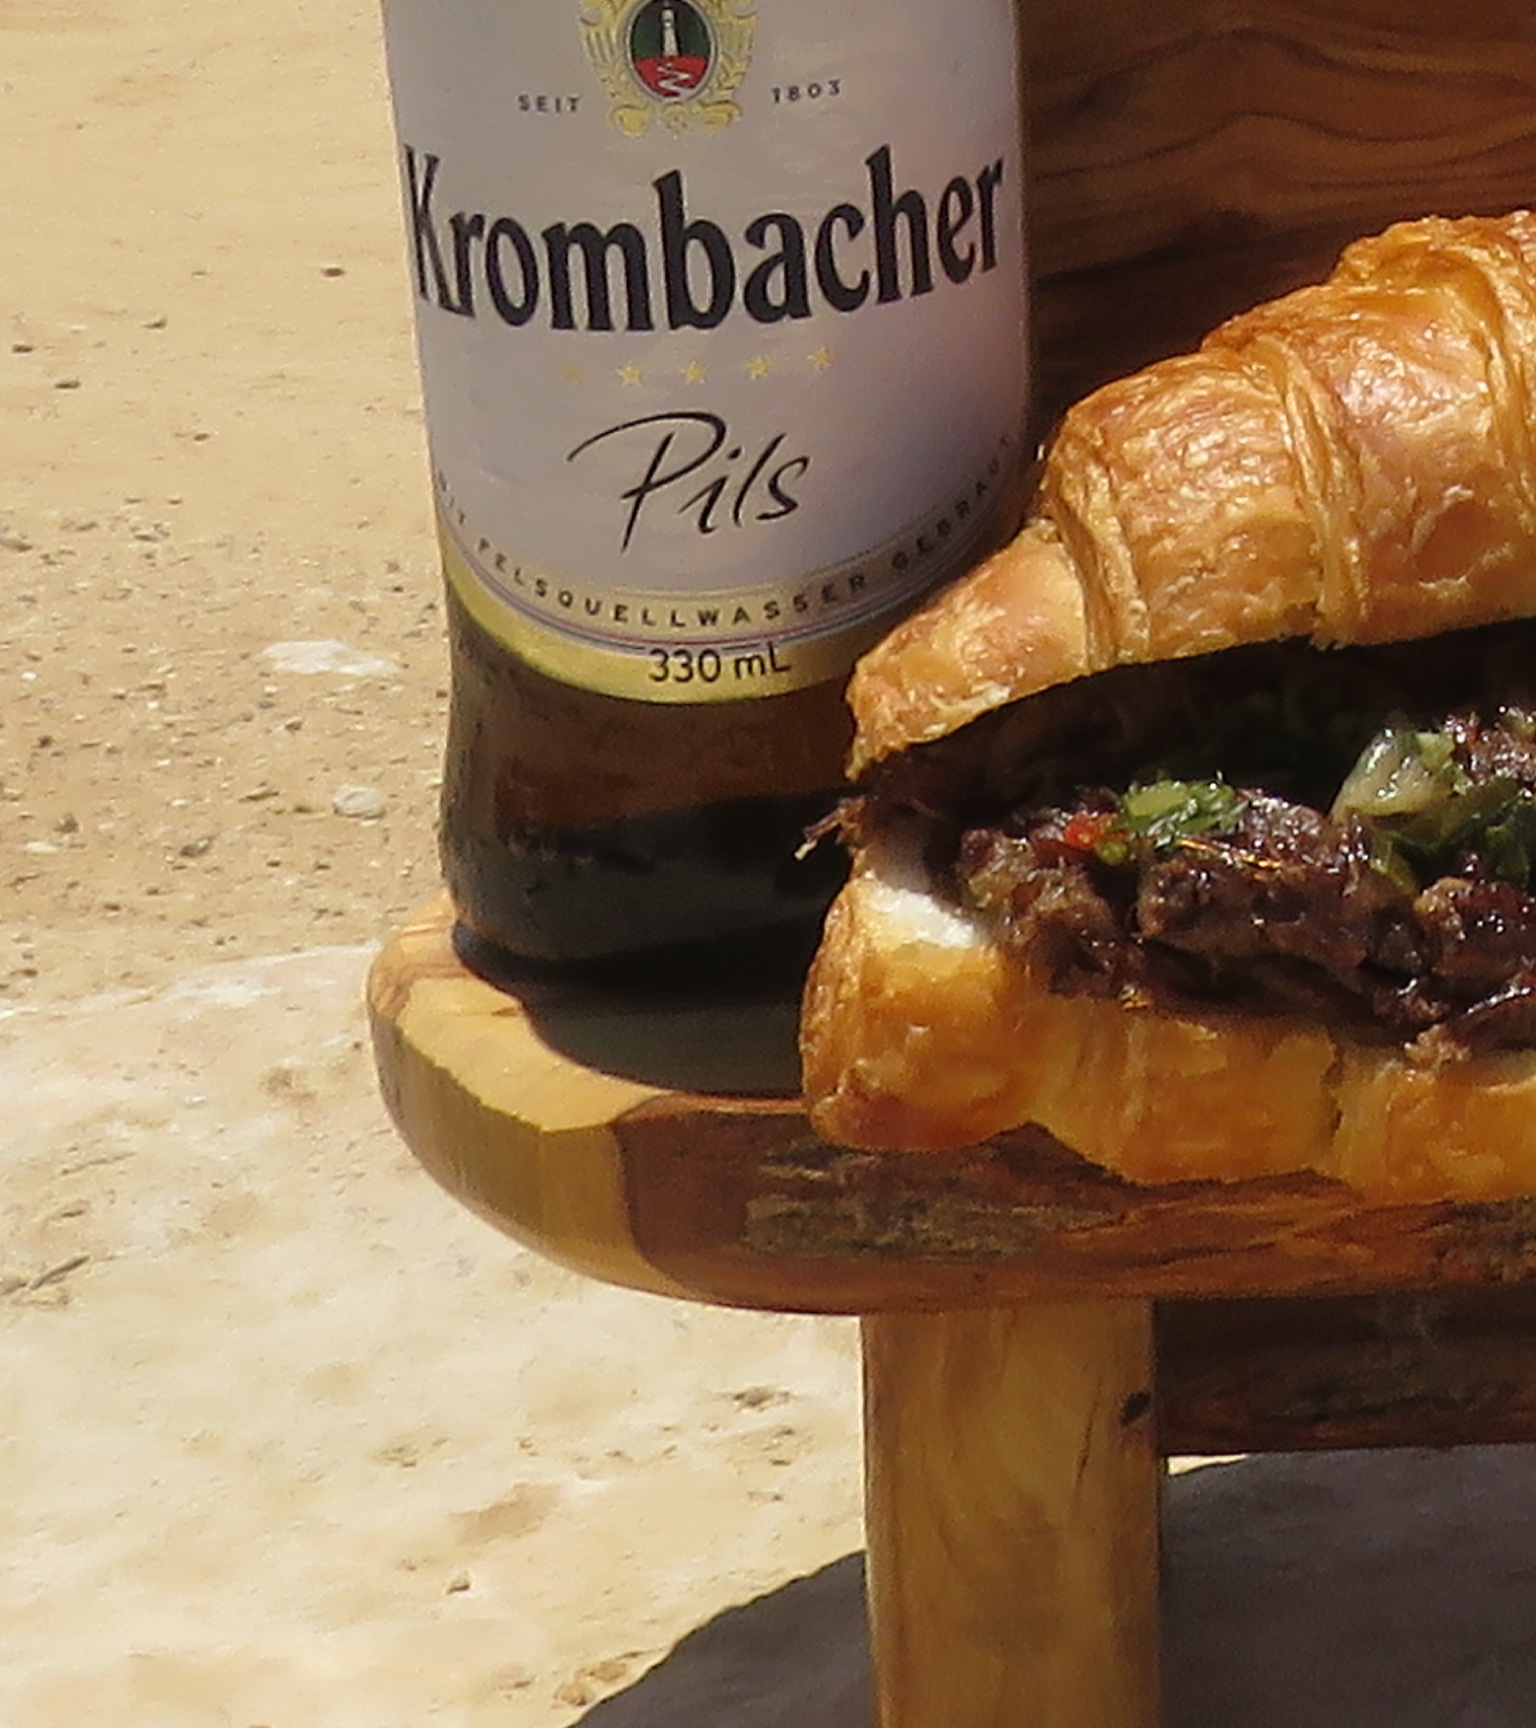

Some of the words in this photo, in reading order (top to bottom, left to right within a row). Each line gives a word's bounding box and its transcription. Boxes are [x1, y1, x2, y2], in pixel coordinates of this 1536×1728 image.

[518, 94, 583, 113] SEIT
[771, 79, 842, 104] 1803
[403, 144, 1005, 332] Krombacher
[566, 412, 810, 554] Pils
[476, 537, 866, 627] FELSQUELLWASSER
[649, 648, 722, 683] 330
[734, 641, 792, 680] mL
